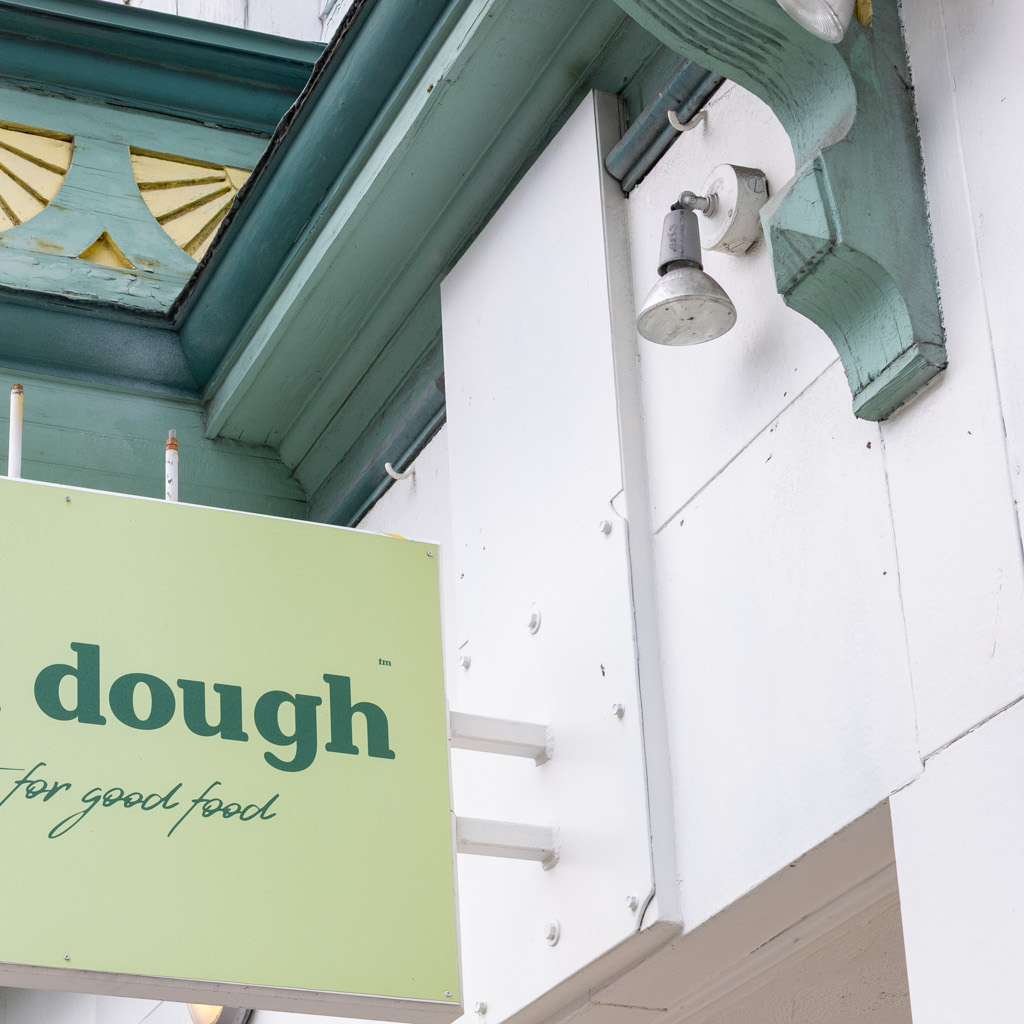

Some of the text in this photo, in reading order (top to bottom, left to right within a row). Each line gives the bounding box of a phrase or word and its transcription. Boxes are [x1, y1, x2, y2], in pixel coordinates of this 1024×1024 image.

[33, 641, 396, 773] dough
[48, 782, 183, 840] good
[167, 780, 280, 838] food
